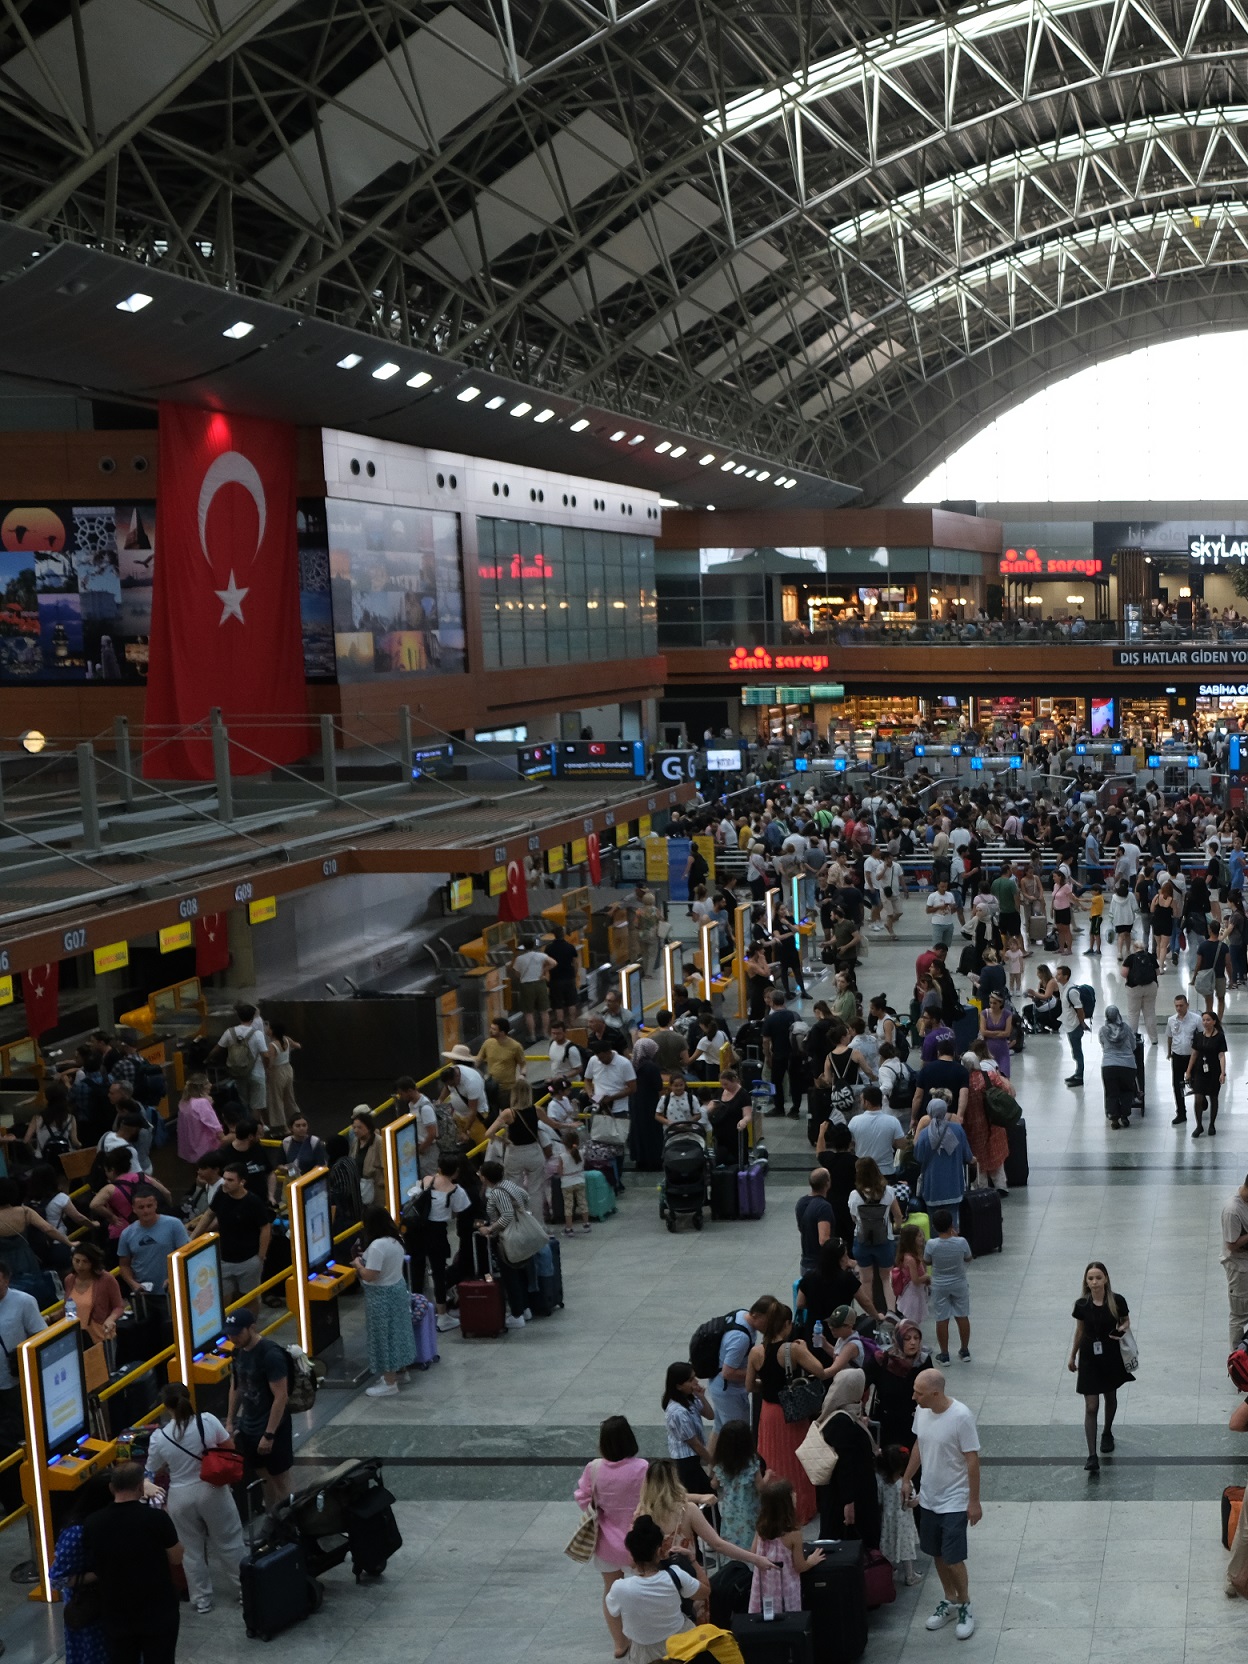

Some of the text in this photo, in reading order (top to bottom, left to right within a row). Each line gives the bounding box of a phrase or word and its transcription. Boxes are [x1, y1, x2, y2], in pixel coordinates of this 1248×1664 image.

[1000, 549, 1102, 576] simit sarayı
[729, 647, 828, 672] simit sarayı
[1120, 652, 1139, 665] DIŞ
[1143, 651, 1188, 663] HATLAR
[1190, 650, 1228, 663] GİDEN
[1199, 684, 1238, 695] SABİHA
[661, 756, 682, 780] G
[180, 898, 198, 918] G08
[64, 929, 86, 951] G07
